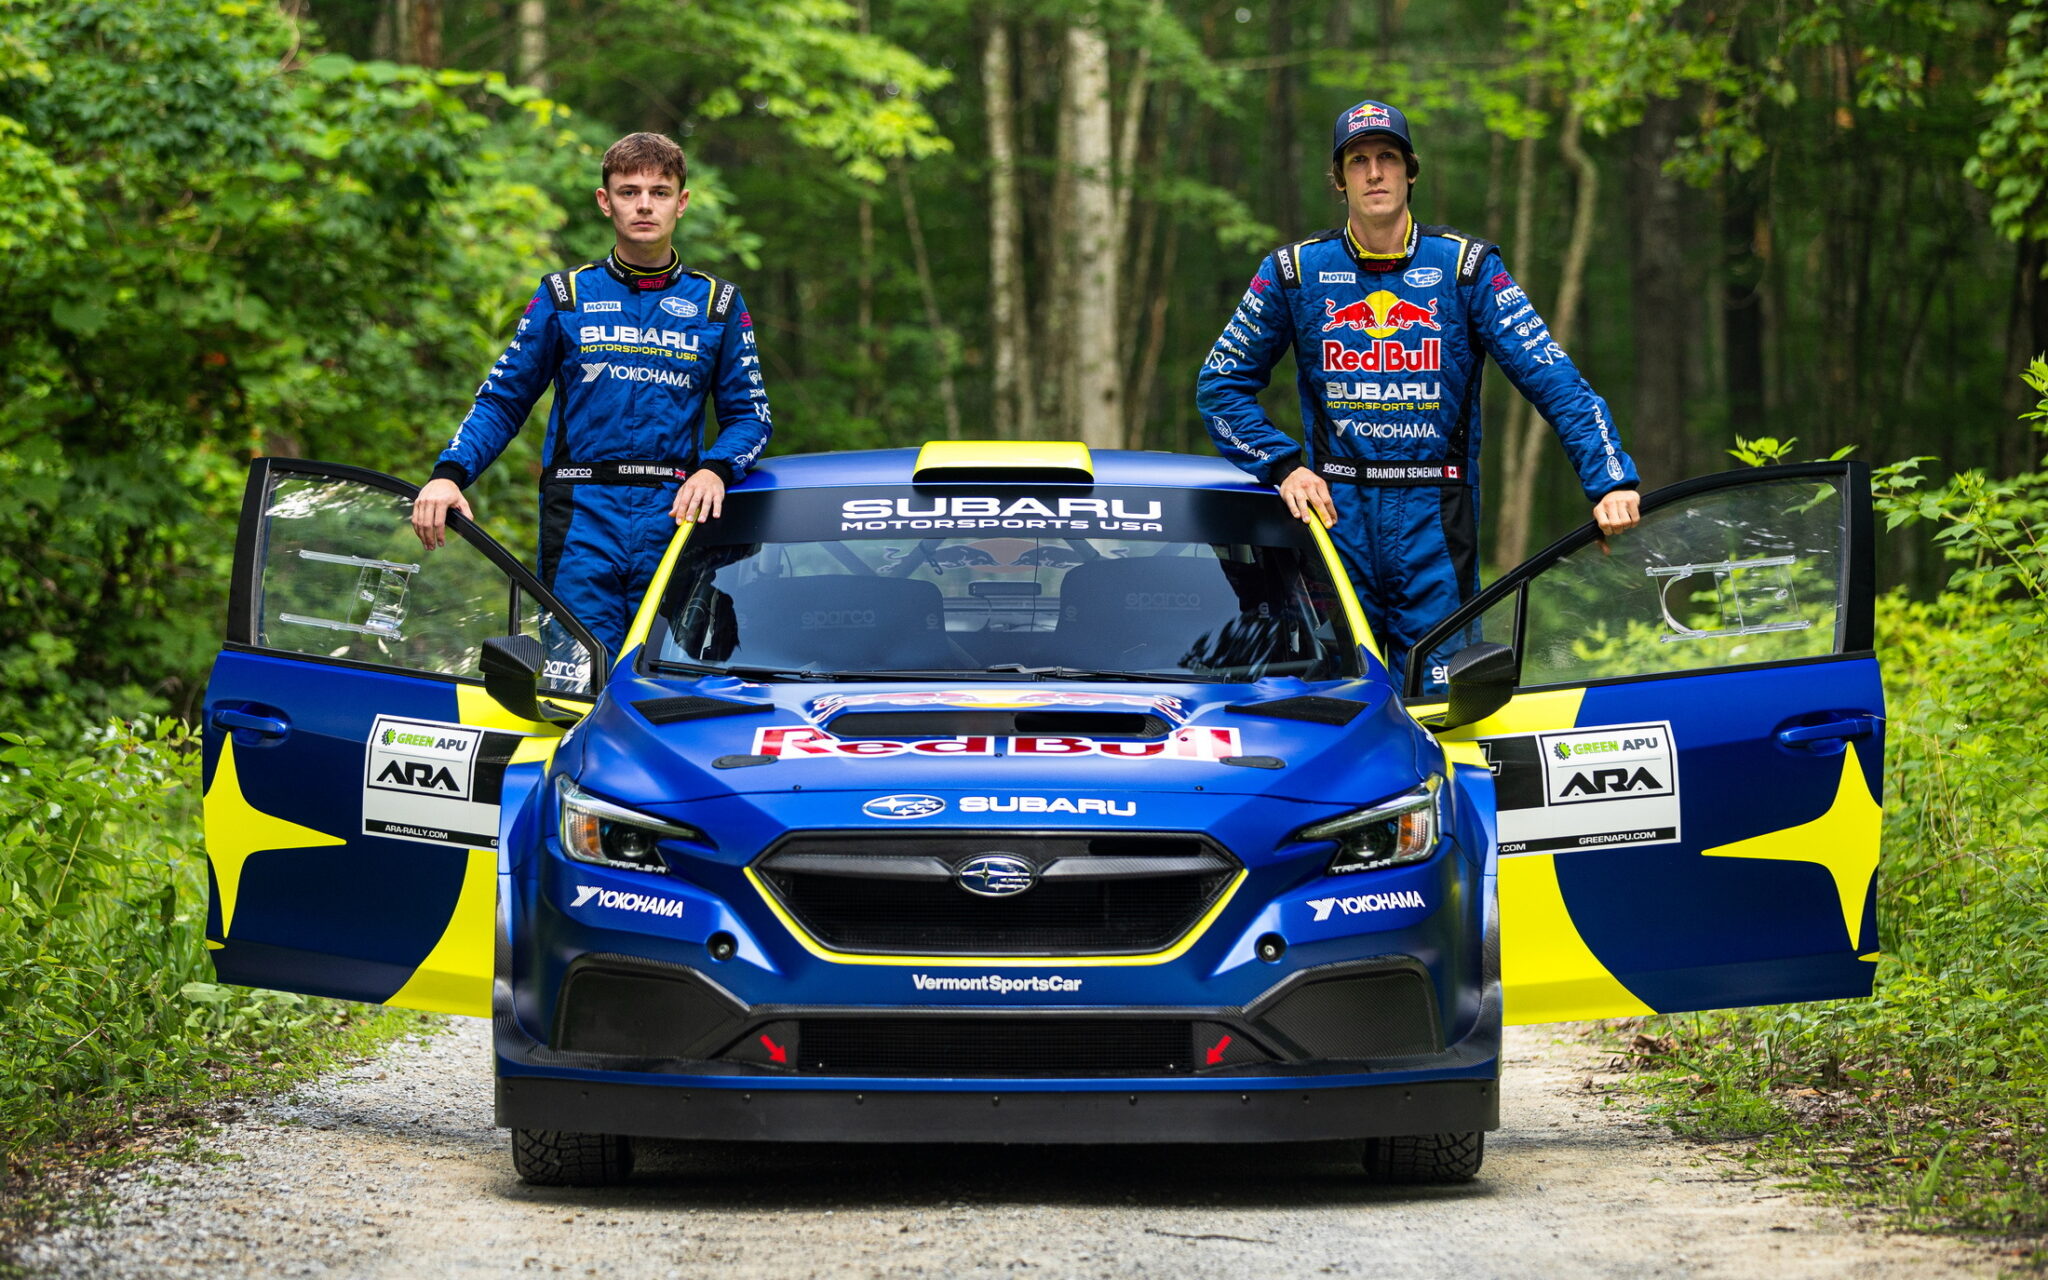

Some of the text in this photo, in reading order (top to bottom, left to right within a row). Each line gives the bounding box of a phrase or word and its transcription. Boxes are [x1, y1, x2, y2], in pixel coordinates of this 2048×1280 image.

[1348, 116, 1391, 133] Red Bull
[1462, 243, 1484, 277] sparco
[1321, 273, 1354, 282] MOTUL
[585, 302, 620, 311] MOTUL
[716, 284, 735, 316] sparco
[580, 326, 699, 352] SUBARU
[581, 344, 698, 362] MOTORSPORTS USA
[1322, 338, 1441, 372] Red Bull
[608, 364, 692, 389] YOKOHAMA
[1325, 382, 1441, 401] SUBARU
[1326, 401, 1440, 411] MOTORSPORTS USA
[1352, 422, 1438, 439] YOKOHAMA
[556, 467, 592, 479] sparco
[618, 465, 644, 475] KEATON
[1322, 462, 1357, 478] sparco
[1366, 466, 1443, 479] BRANDON SEMENUK
[842, 497, 1162, 520] SUBARU
[841, 519, 1163, 532] MOTORSPORTS USA
[801, 609, 876, 631] sparco
[396, 732, 468, 752] GREEN APU
[751, 726, 1243, 761] Red Bull
[1573, 736, 1659, 755] GREEN APU
[376, 759, 461, 793] ARA
[1559, 766, 1664, 798] ARA
[958, 795, 1137, 817] SUBARU
[385, 824, 449, 840] ARA-RALLY.COM
[1578, 830, 1656, 846] GREENAPU.COM
[608, 859, 670, 874] TRIPLE-R
[598, 889, 684, 919] YOKOHAMA
[1335, 890, 1426, 915] YOKOHAMA
[912, 973, 1083, 995] VermontSportsCar
